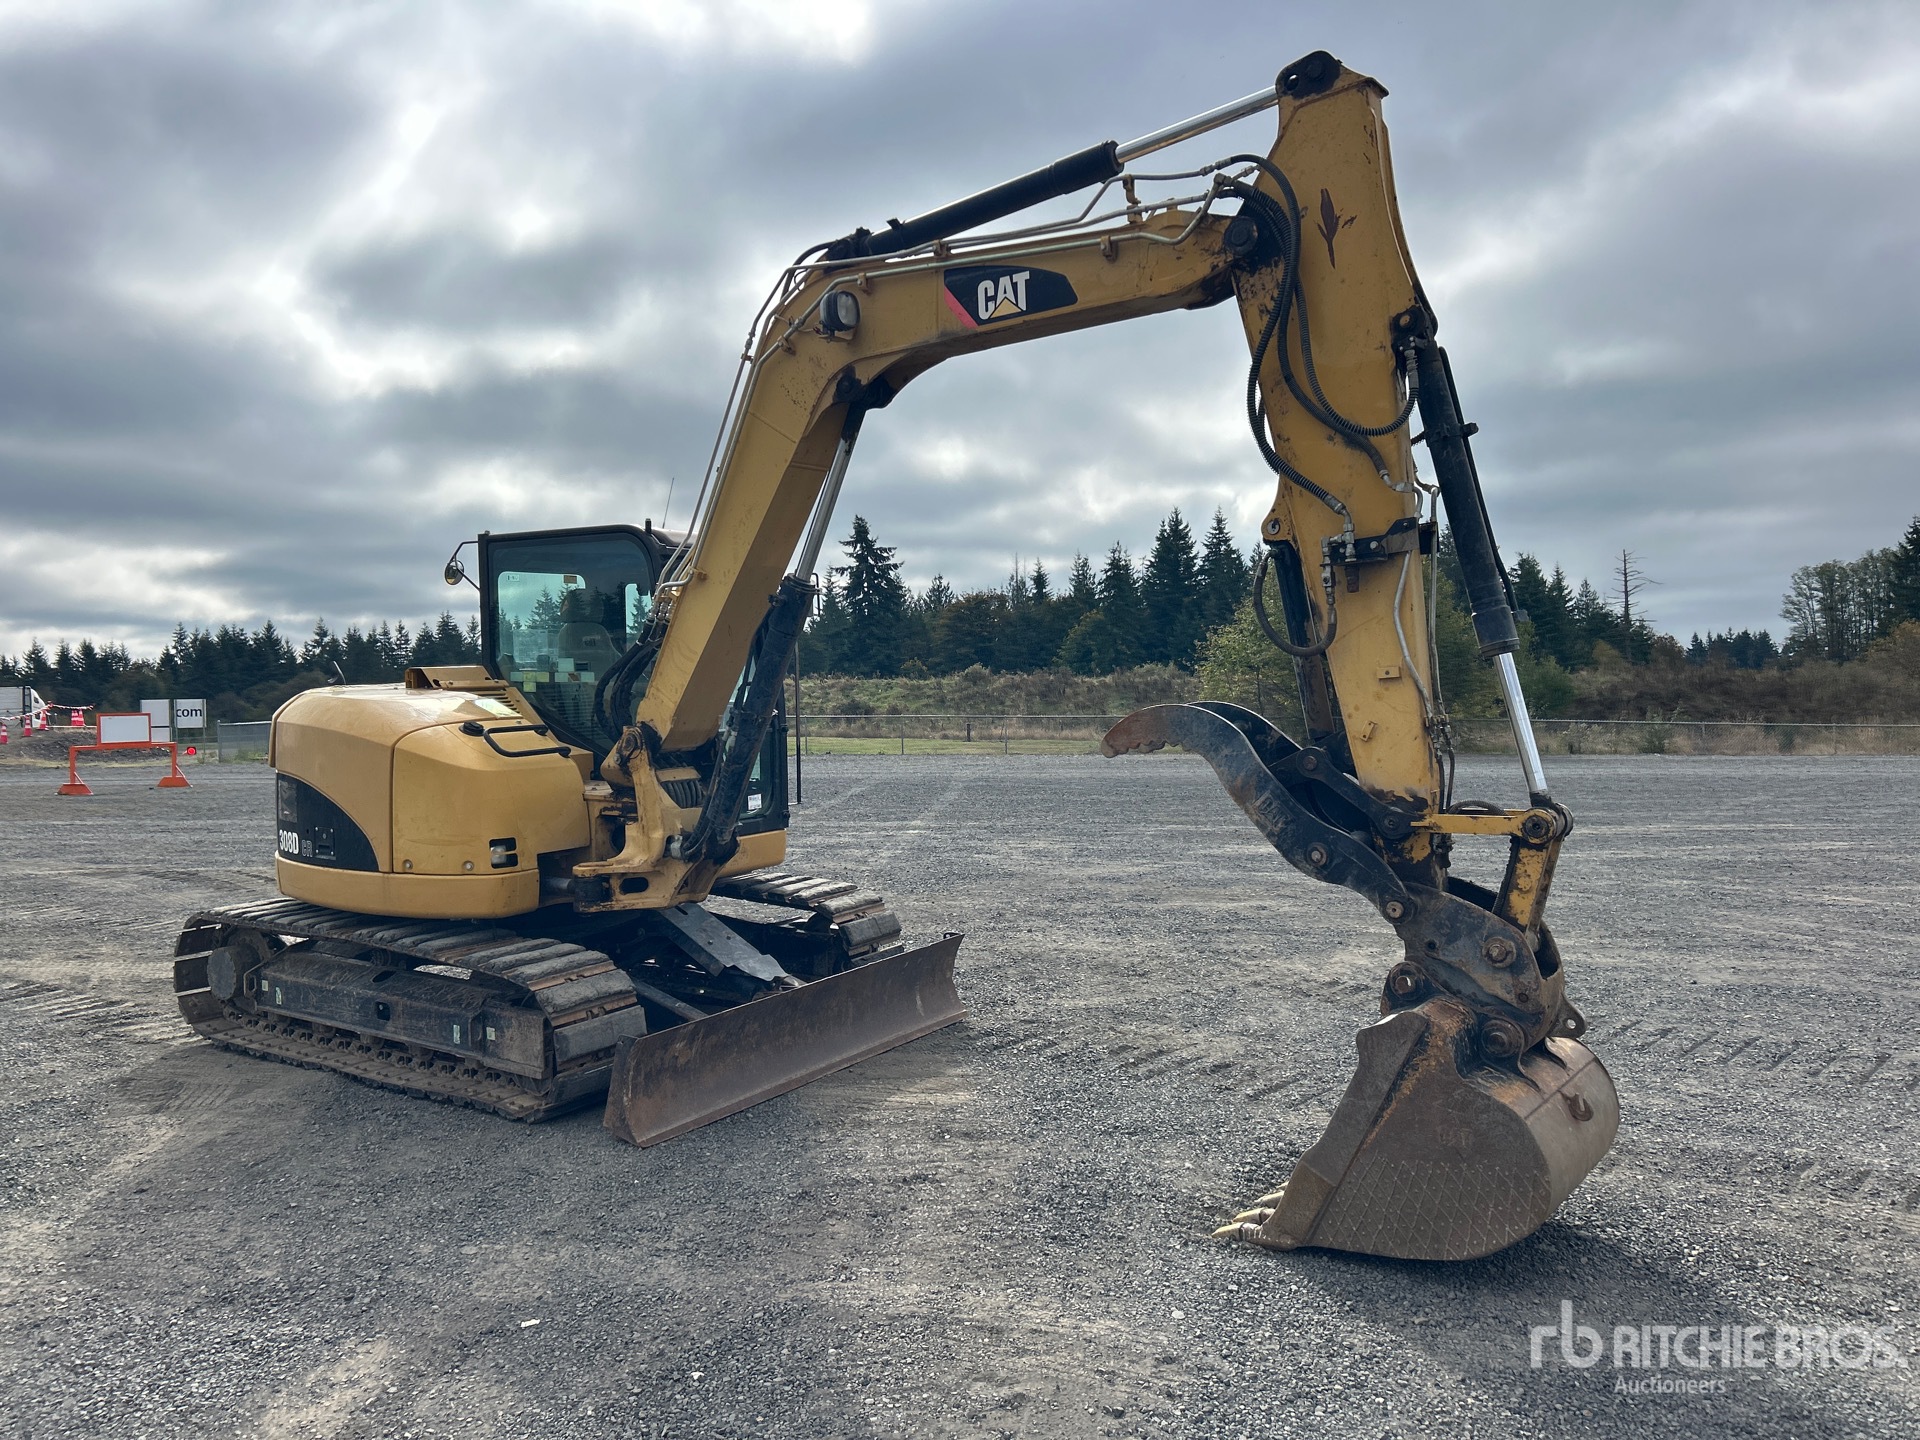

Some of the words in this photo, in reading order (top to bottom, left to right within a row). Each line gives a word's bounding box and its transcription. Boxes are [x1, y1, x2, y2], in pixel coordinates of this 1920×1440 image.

[977, 270, 1030, 320] CAT
[279, 829, 300, 855] 308D
[301, 839, 313, 858] CR
